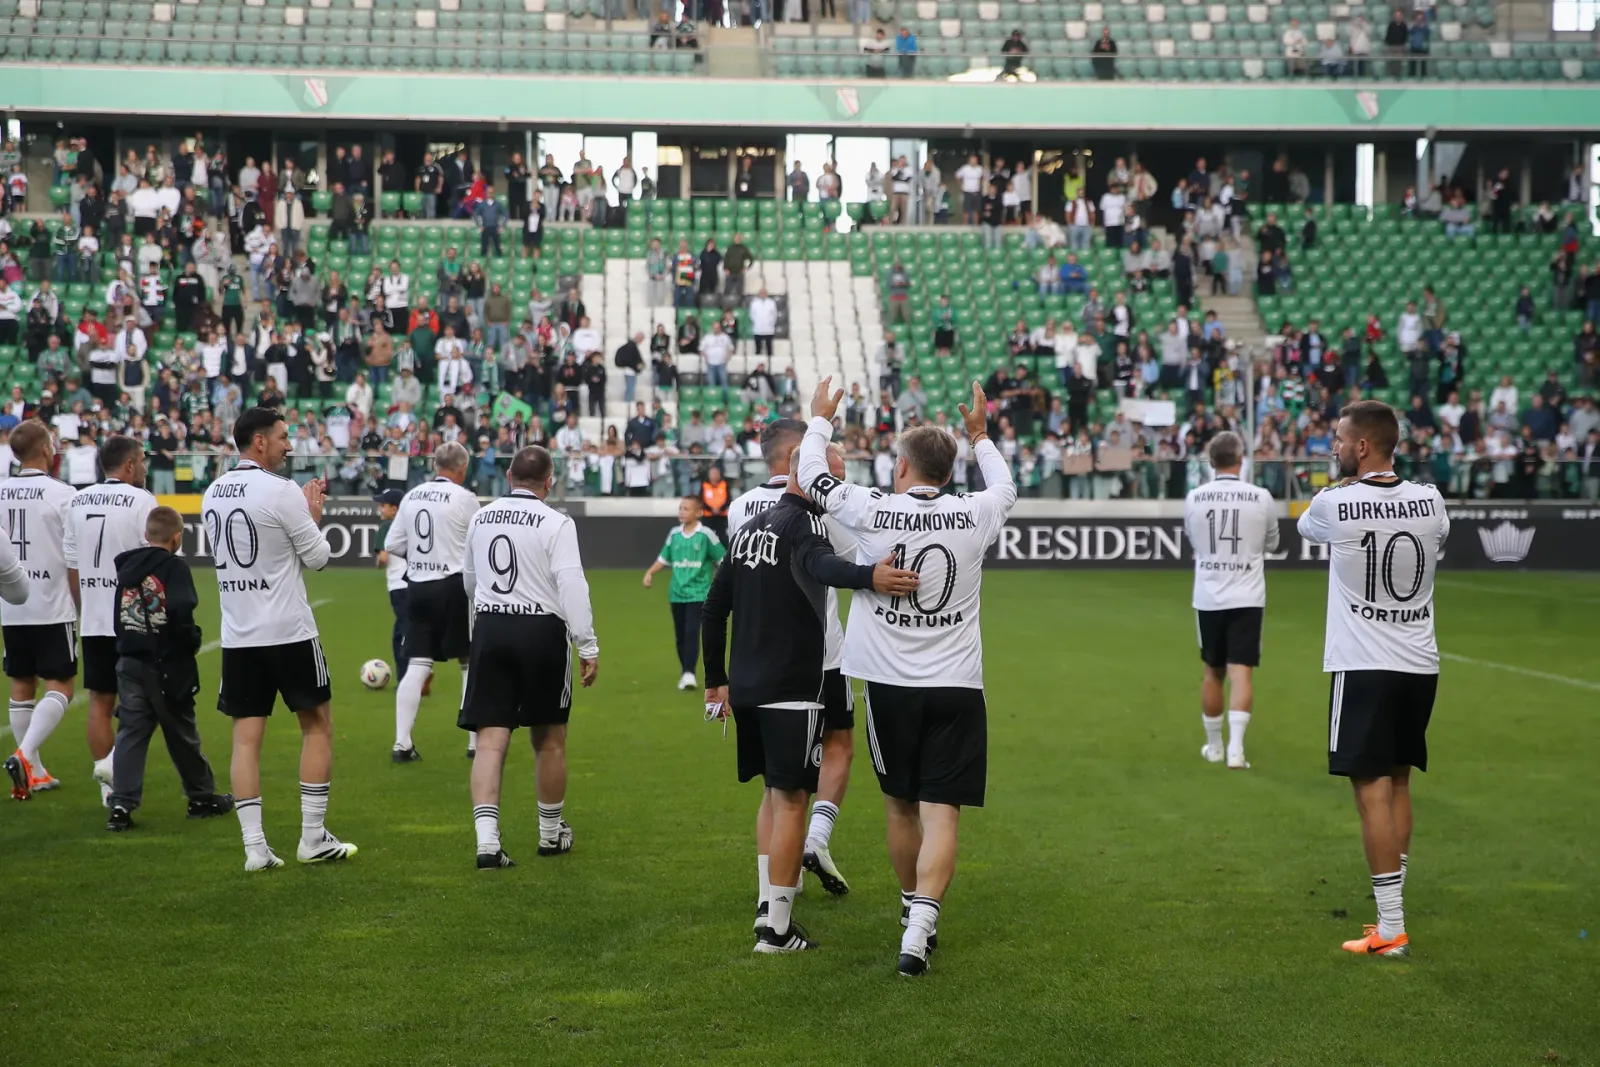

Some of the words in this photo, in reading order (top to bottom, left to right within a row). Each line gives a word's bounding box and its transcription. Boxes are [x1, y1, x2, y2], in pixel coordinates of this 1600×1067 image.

[0, 487, 45, 500] EWCZUK
[71, 493, 135, 508] BRONOWICKI
[212, 483, 248, 499] DUDEK
[409, 490, 452, 503] ADAMCZYK
[1194, 491, 1260, 503] WAWRZYNIAK
[1338, 498, 1436, 521] BURKHARDT
[8, 508, 31, 561] 4
[86, 513, 106, 569] 7
[204, 507, 259, 570] 20
[415, 508, 435, 555] 9
[990, 525, 1185, 560] RESIDEN
[1206, 508, 1243, 556] 14
[408, 561, 451, 573] FORTUNA
[488, 534, 519, 595] 9
[1199, 560, 1252, 572] FORTUNA
[1360, 530, 1426, 603] 10
[218, 578, 271, 593] ORTUNA
[889, 542, 957, 616] 10
[475, 602, 545, 615] FORTUNA
[874, 605, 964, 628] FORTUNA
[1350, 603, 1431, 624] FORTUNA
